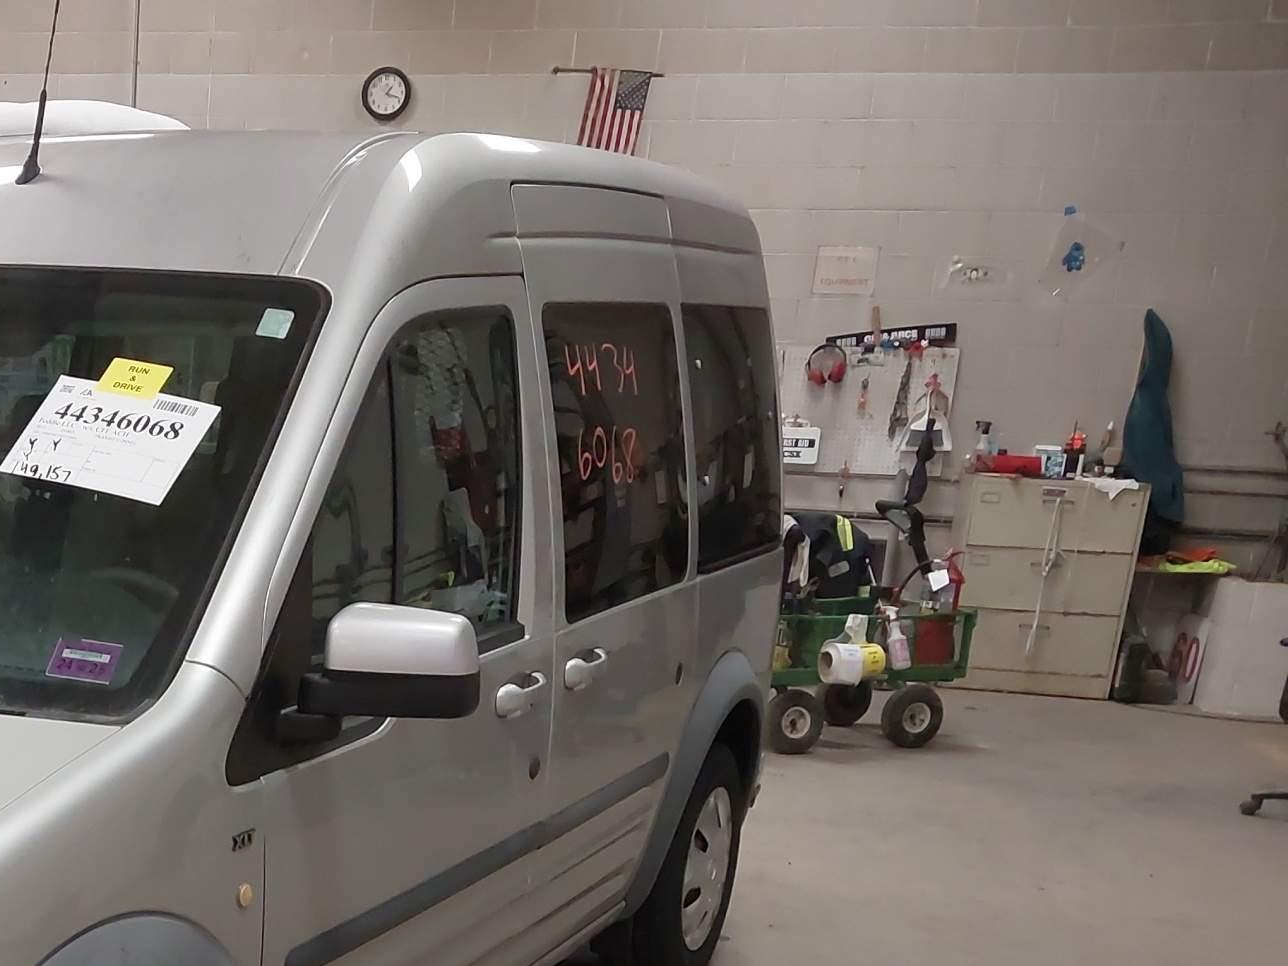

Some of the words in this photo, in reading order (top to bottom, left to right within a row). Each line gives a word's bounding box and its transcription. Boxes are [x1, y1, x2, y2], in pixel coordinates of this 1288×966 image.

[113, 381, 143, 392] DRIVE
[128, 366, 150, 375] RUN
[564, 343, 638, 395] 4434
[55, 402, 184, 440] 44346068
[578, 425, 636, 484] 6068
